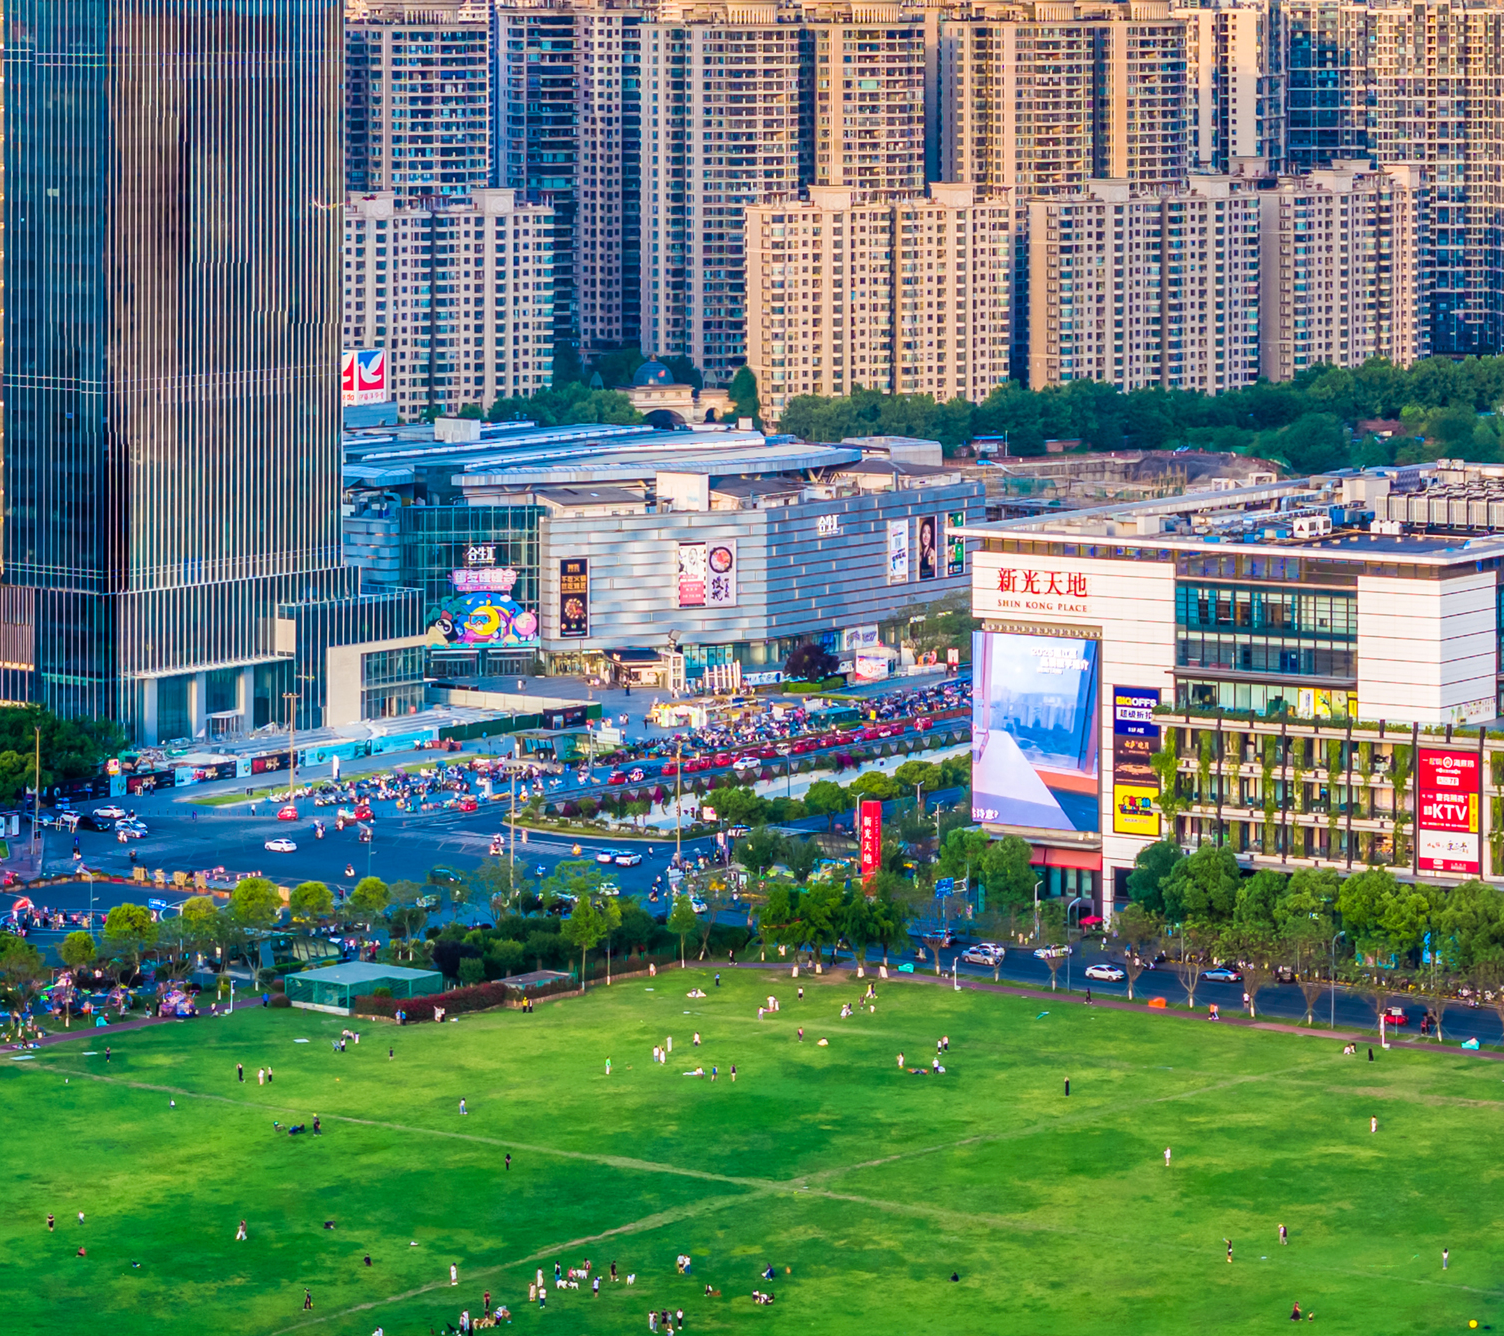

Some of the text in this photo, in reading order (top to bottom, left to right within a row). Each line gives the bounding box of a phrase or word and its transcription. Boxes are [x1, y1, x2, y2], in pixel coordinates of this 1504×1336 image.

[818, 514, 841, 532] 合生汇
[467, 546, 496, 561] 合生汇
[997, 568, 1087, 598] 新光天地
[997, 599, 1088, 613] SHIN KONG PLACE
[1116, 696, 1157, 708] BIGOFFS
[1433, 803, 1468, 821] KTV
[863, 816, 873, 865] 新光天地
